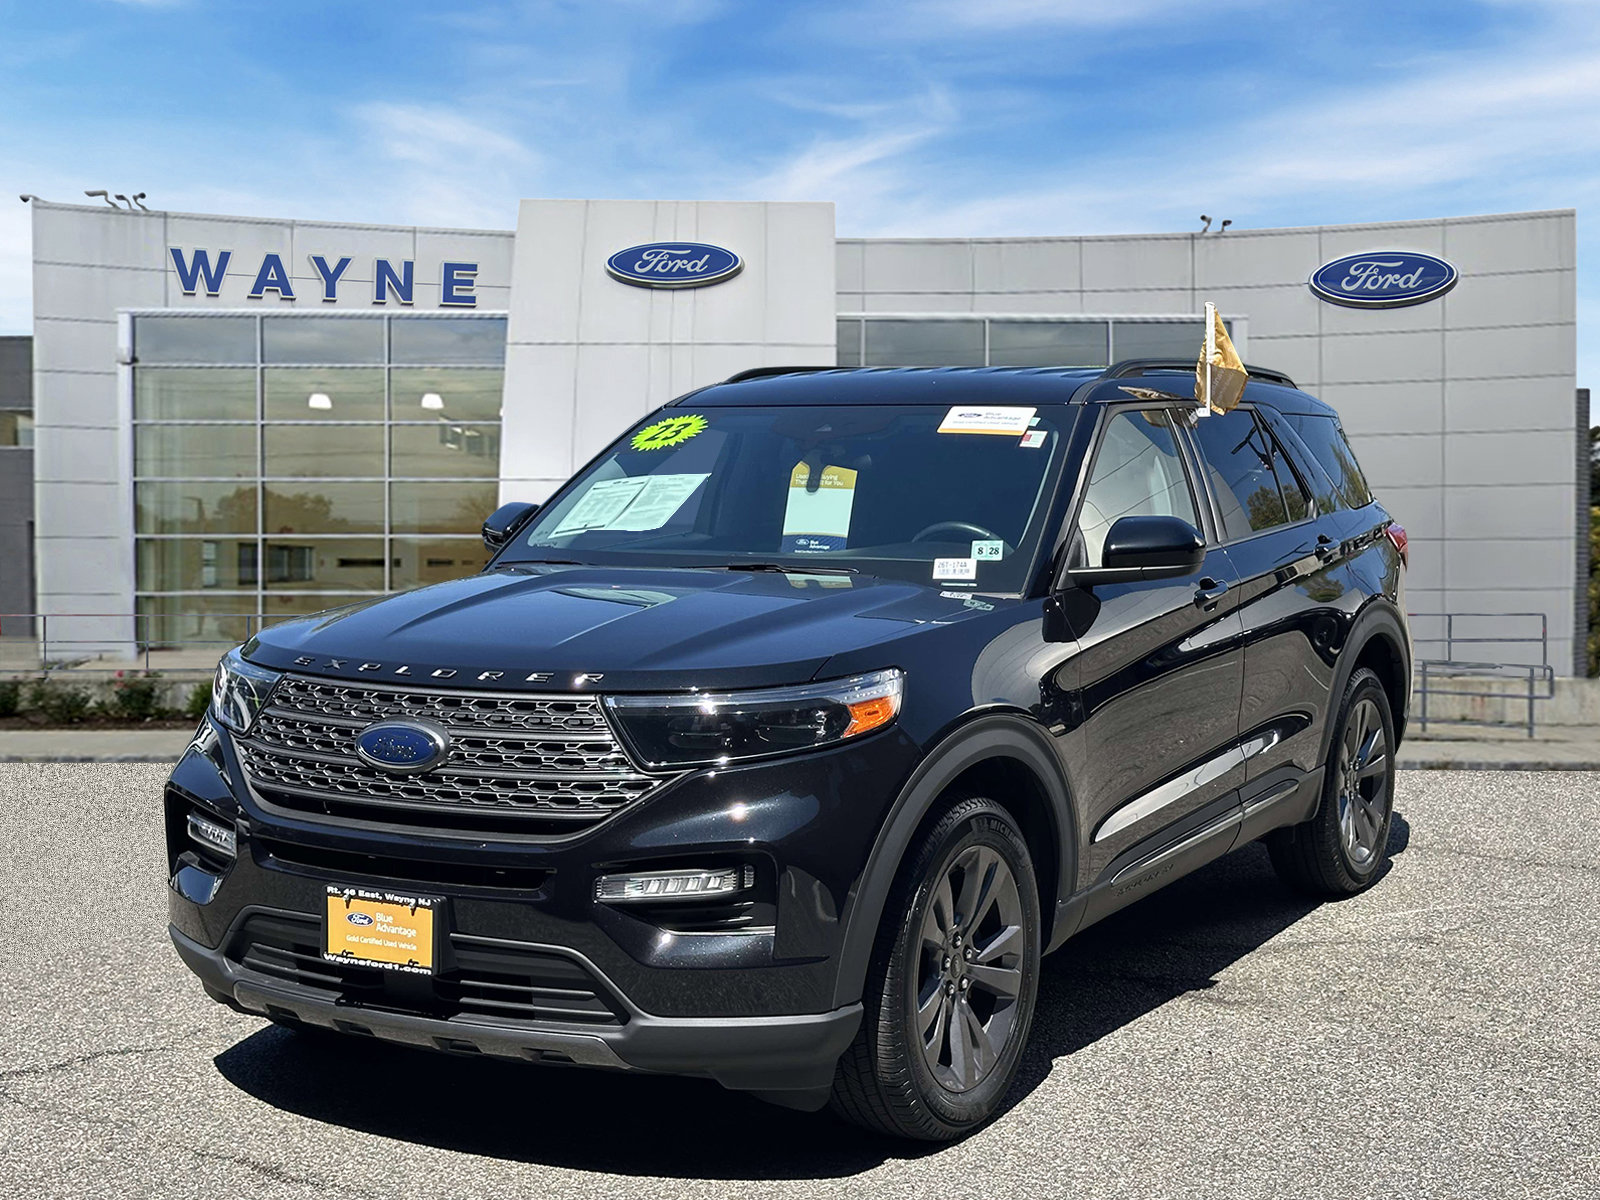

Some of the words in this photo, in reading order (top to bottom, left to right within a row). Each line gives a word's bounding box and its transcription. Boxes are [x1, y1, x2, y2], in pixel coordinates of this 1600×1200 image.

[634, 249, 711, 273] Ford
[168, 246, 480, 307] WAYNE
[1341, 261, 1425, 291] Ford
[644, 422, 693, 442] 23
[977, 547, 984, 555] 8
[989, 547, 1000, 555] 28
[293, 656, 605, 684] EXPLORER
[327, 886, 341, 894] Rt.
[418, 898, 431, 906] NJ
[376, 912, 394, 923] Blue
[376, 923, 417, 938] Advantage
[360, 936, 383, 946] Certified
[383, 939, 397, 948] Used
[398, 941, 417, 951] Vehicle
